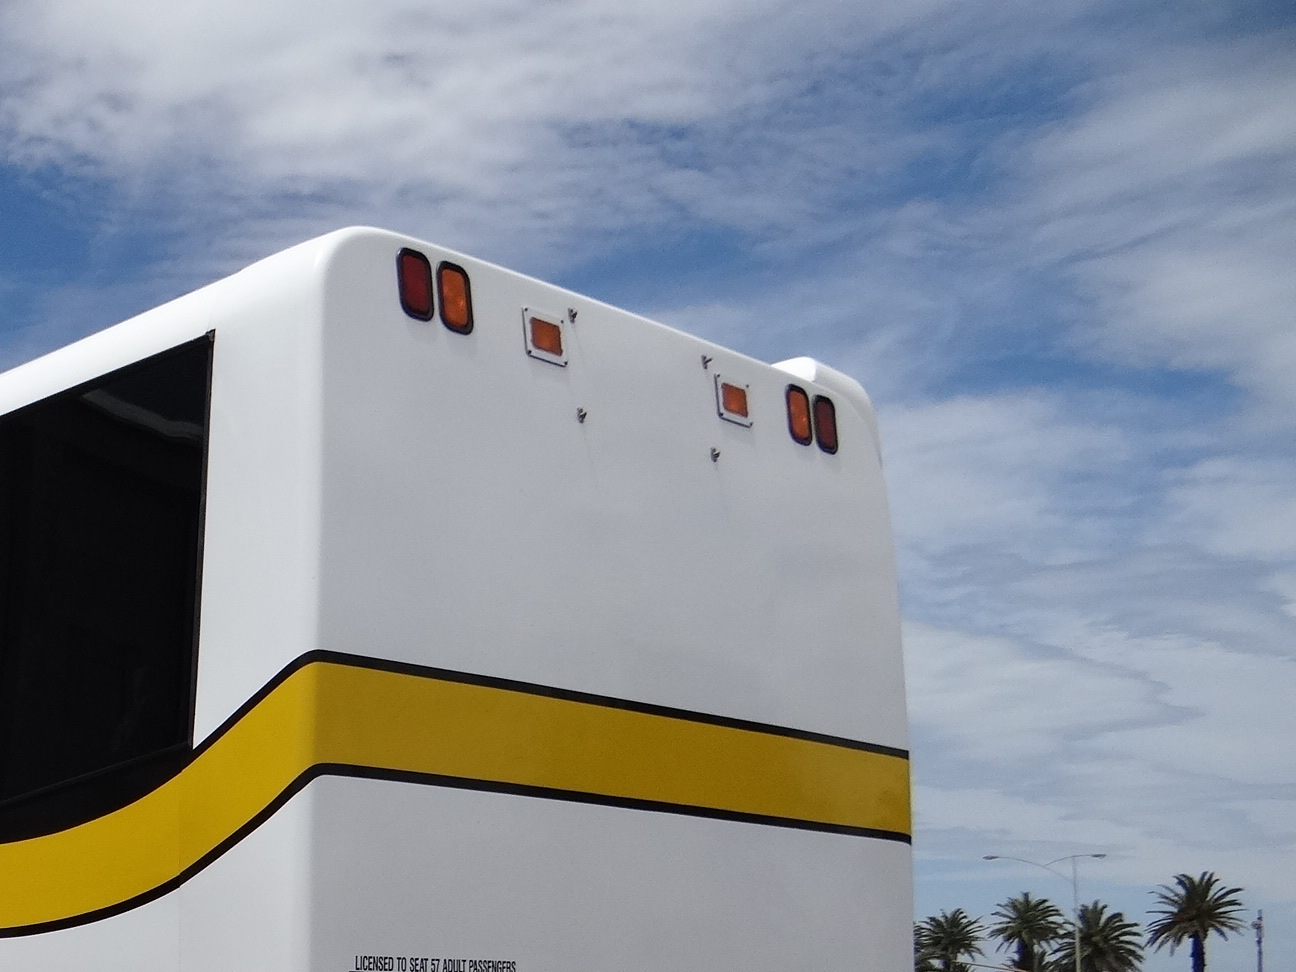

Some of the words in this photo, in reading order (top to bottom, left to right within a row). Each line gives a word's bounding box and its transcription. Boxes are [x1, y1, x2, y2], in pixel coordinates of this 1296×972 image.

[355, 955, 394, 972] LICENSED
[397, 957, 407, 972] TO
[409, 957, 429, 972] SEAT
